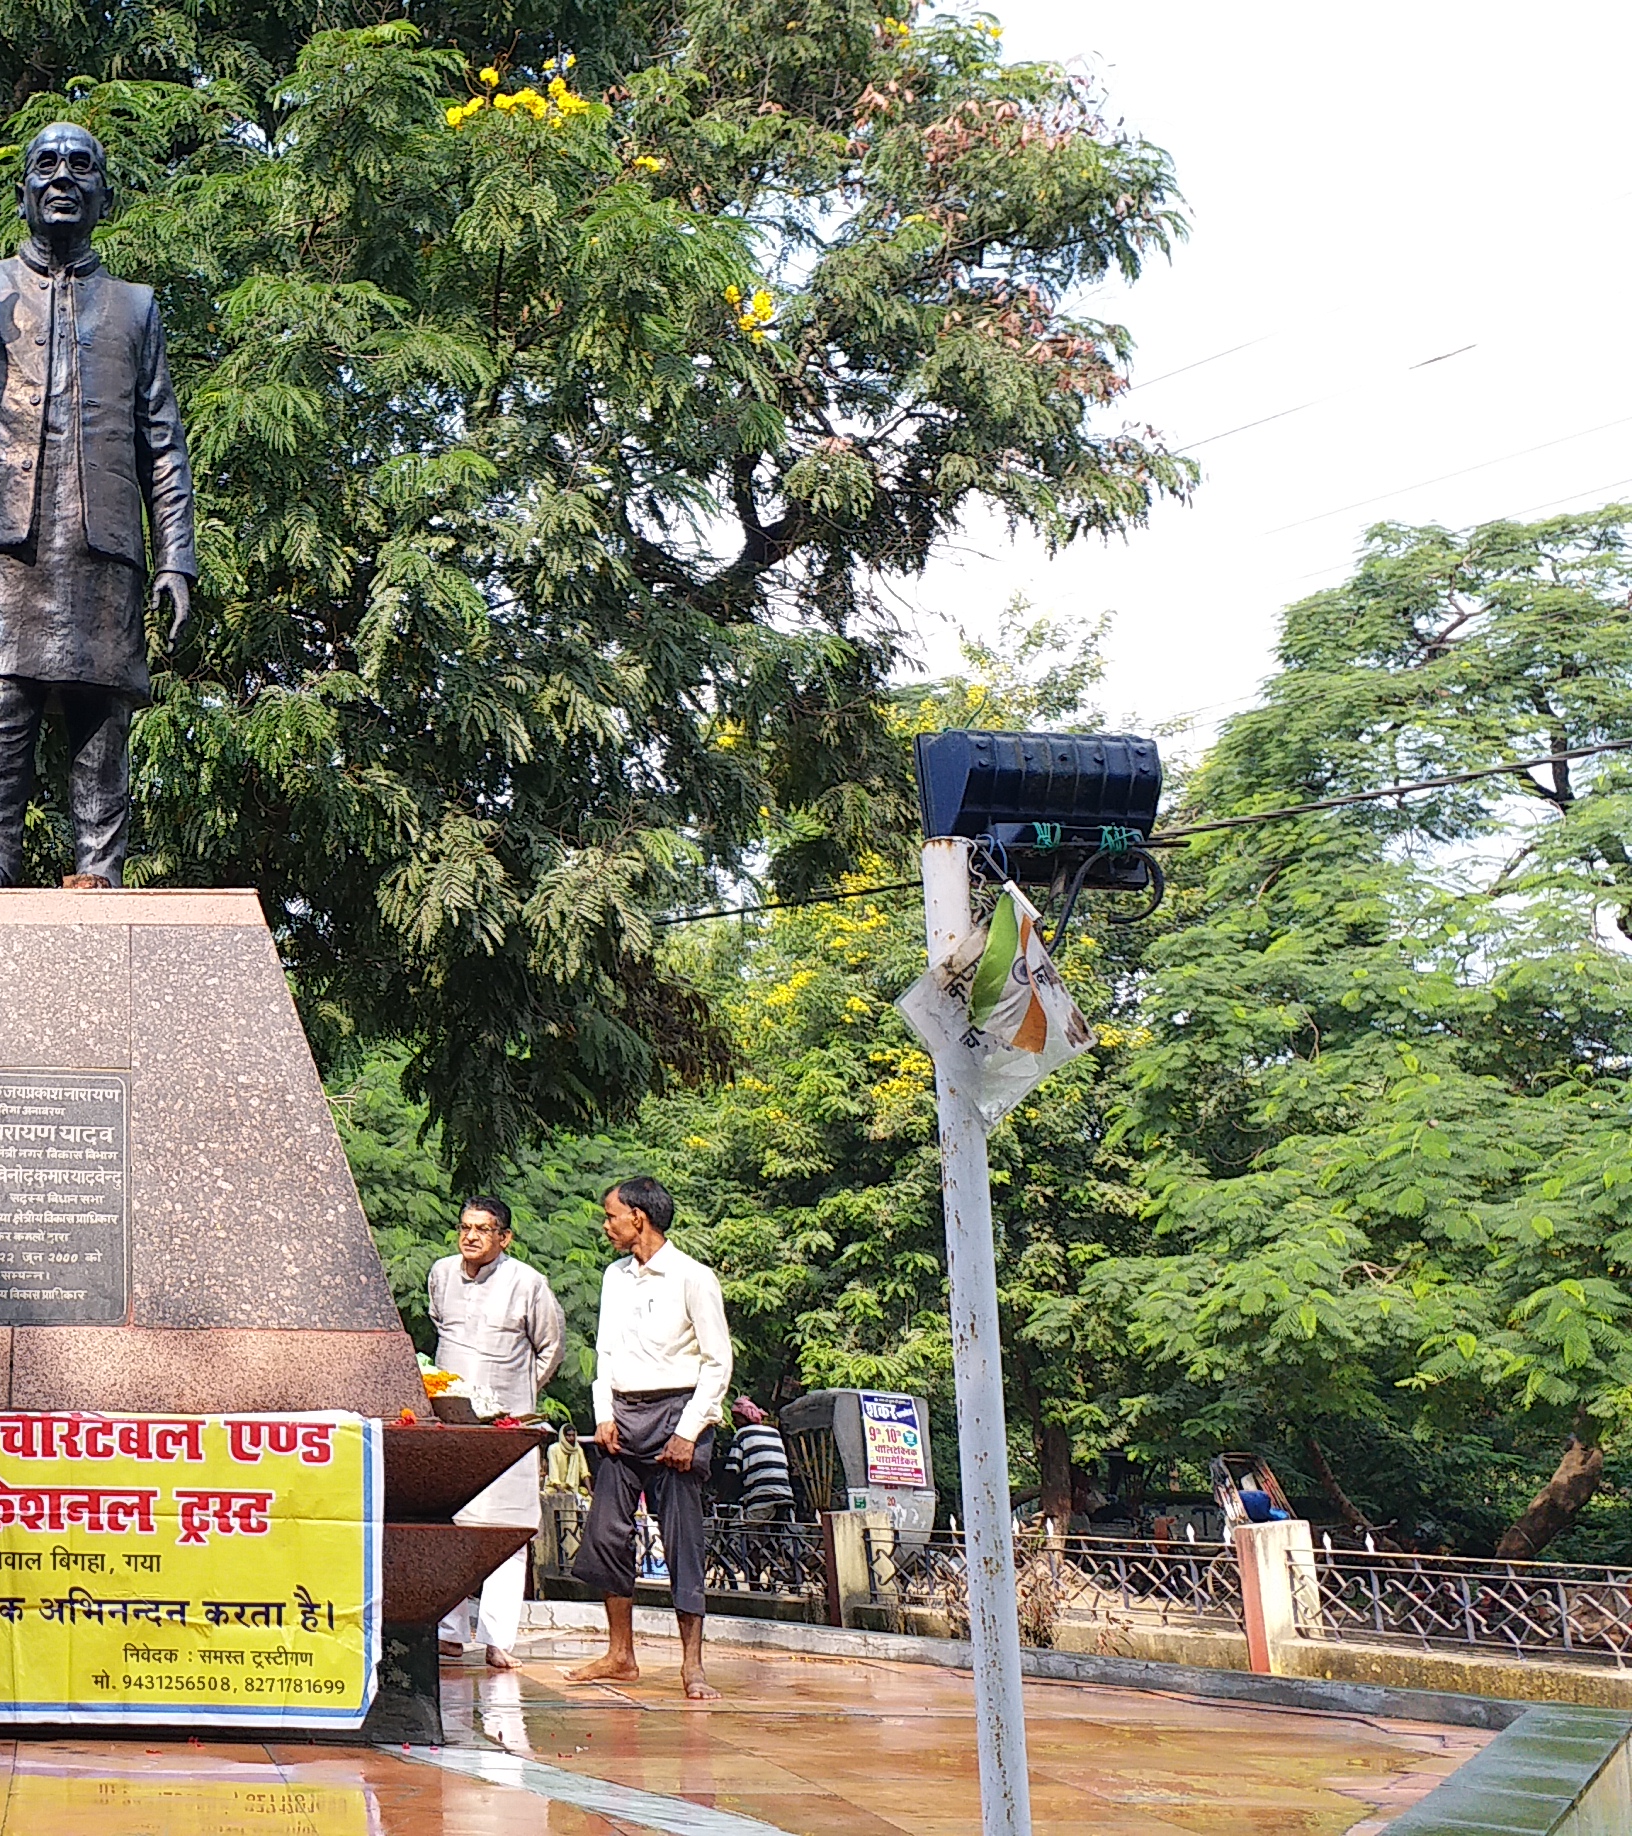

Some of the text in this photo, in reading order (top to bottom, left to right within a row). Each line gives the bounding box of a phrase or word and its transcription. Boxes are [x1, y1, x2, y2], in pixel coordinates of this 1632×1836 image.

[63, 1087, 121, 1102] नारायण
[59, 1126, 115, 1146] यादव
[18, 1149, 44, 1159] नगर
[45, 1147, 83, 1160] विकास
[85, 1148, 119, 1160] विभाग
[84, 1248, 103, 1262] को
[224, 1420, 336, 1464] एण्ड
[176, 1490, 273, 1544] ट्रस्ट
[51, 1545, 115, 1574] बिगहा,
[122, 1553, 161, 1573] गया
[39, 1586, 190, 1628] अभिनन्दन
[202, 1600, 286, 1629] करता
[123, 1643, 179, 1664] निवेदक
[197, 1649, 245, 1666] समस्त
[250, 1646, 313, 1669] ट्रस्टीगण
[92, 1669, 117, 1690] मो.
[244, 1678, 346, 1695] 8271781699
